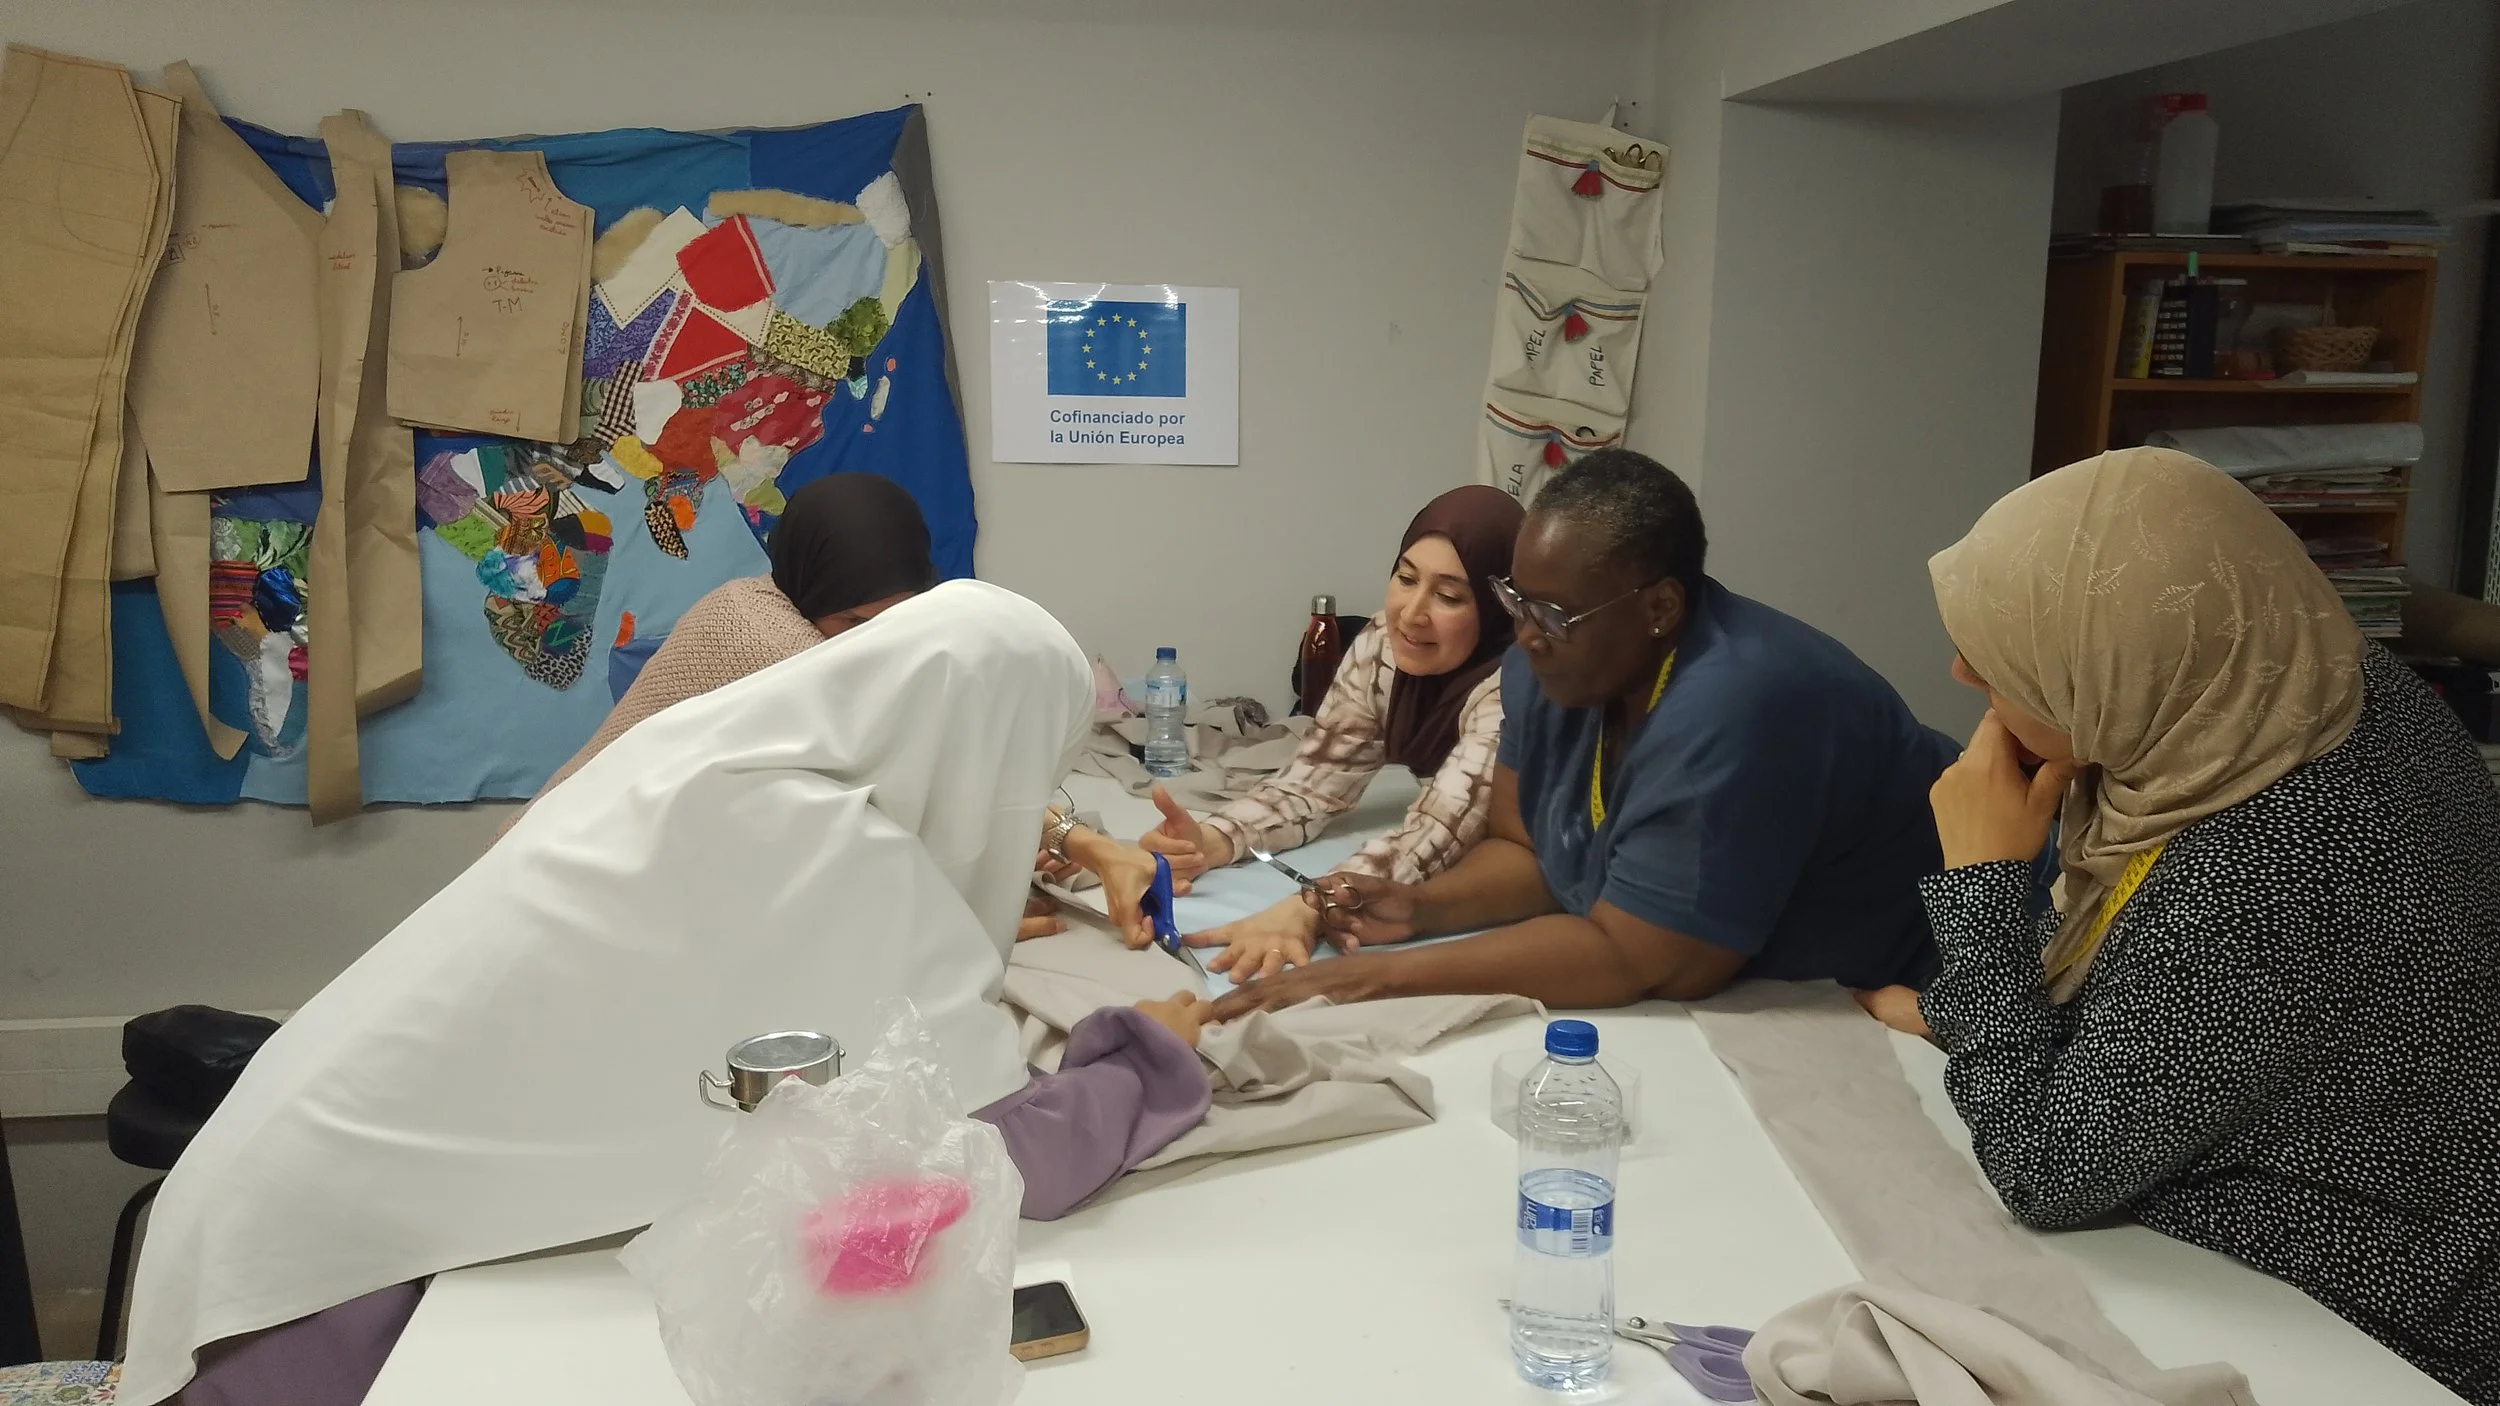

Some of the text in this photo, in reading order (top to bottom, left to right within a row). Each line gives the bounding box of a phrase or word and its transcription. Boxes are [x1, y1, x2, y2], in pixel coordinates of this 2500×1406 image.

[1526, 329, 1547, 369] APEL
[1588, 346, 1605, 387] PAPEL
[1050, 409, 1186, 427] Cofinanciado por
[1050, 430, 1185, 447] la Unión Europea
[1508, 464, 1525, 497] ELA
